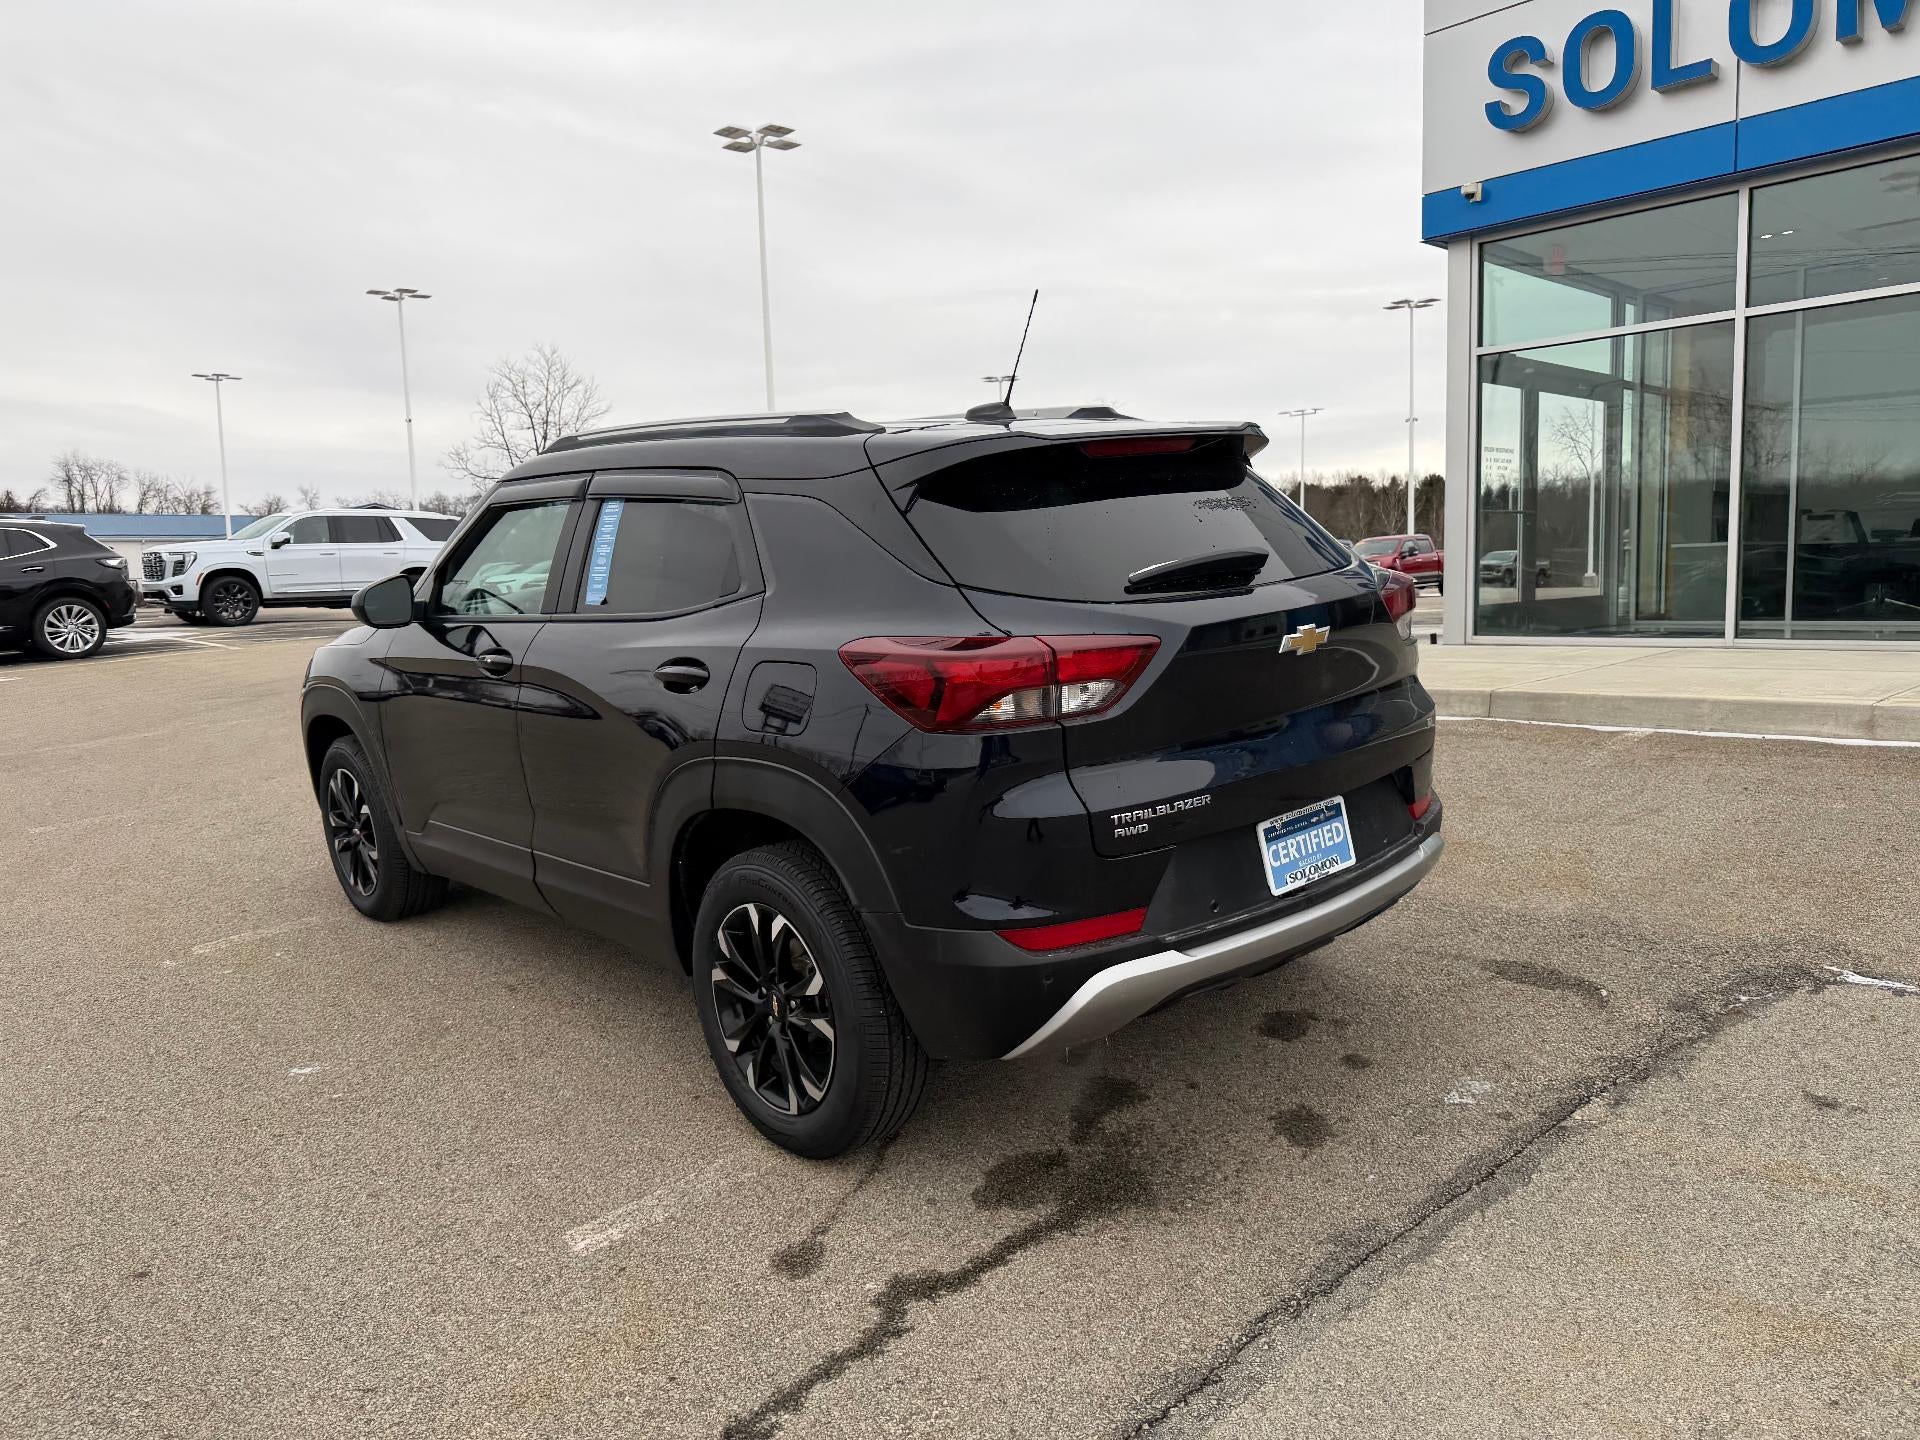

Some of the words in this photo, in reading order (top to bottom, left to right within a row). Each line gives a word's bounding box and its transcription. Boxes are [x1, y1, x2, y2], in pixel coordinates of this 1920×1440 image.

[1111, 794, 1212, 826] TRAILBLAZER
[1114, 823, 1149, 839] AWD
[1268, 822, 1344, 868] CERTIFIED
[1289, 855, 1339, 884] SOLOMON
